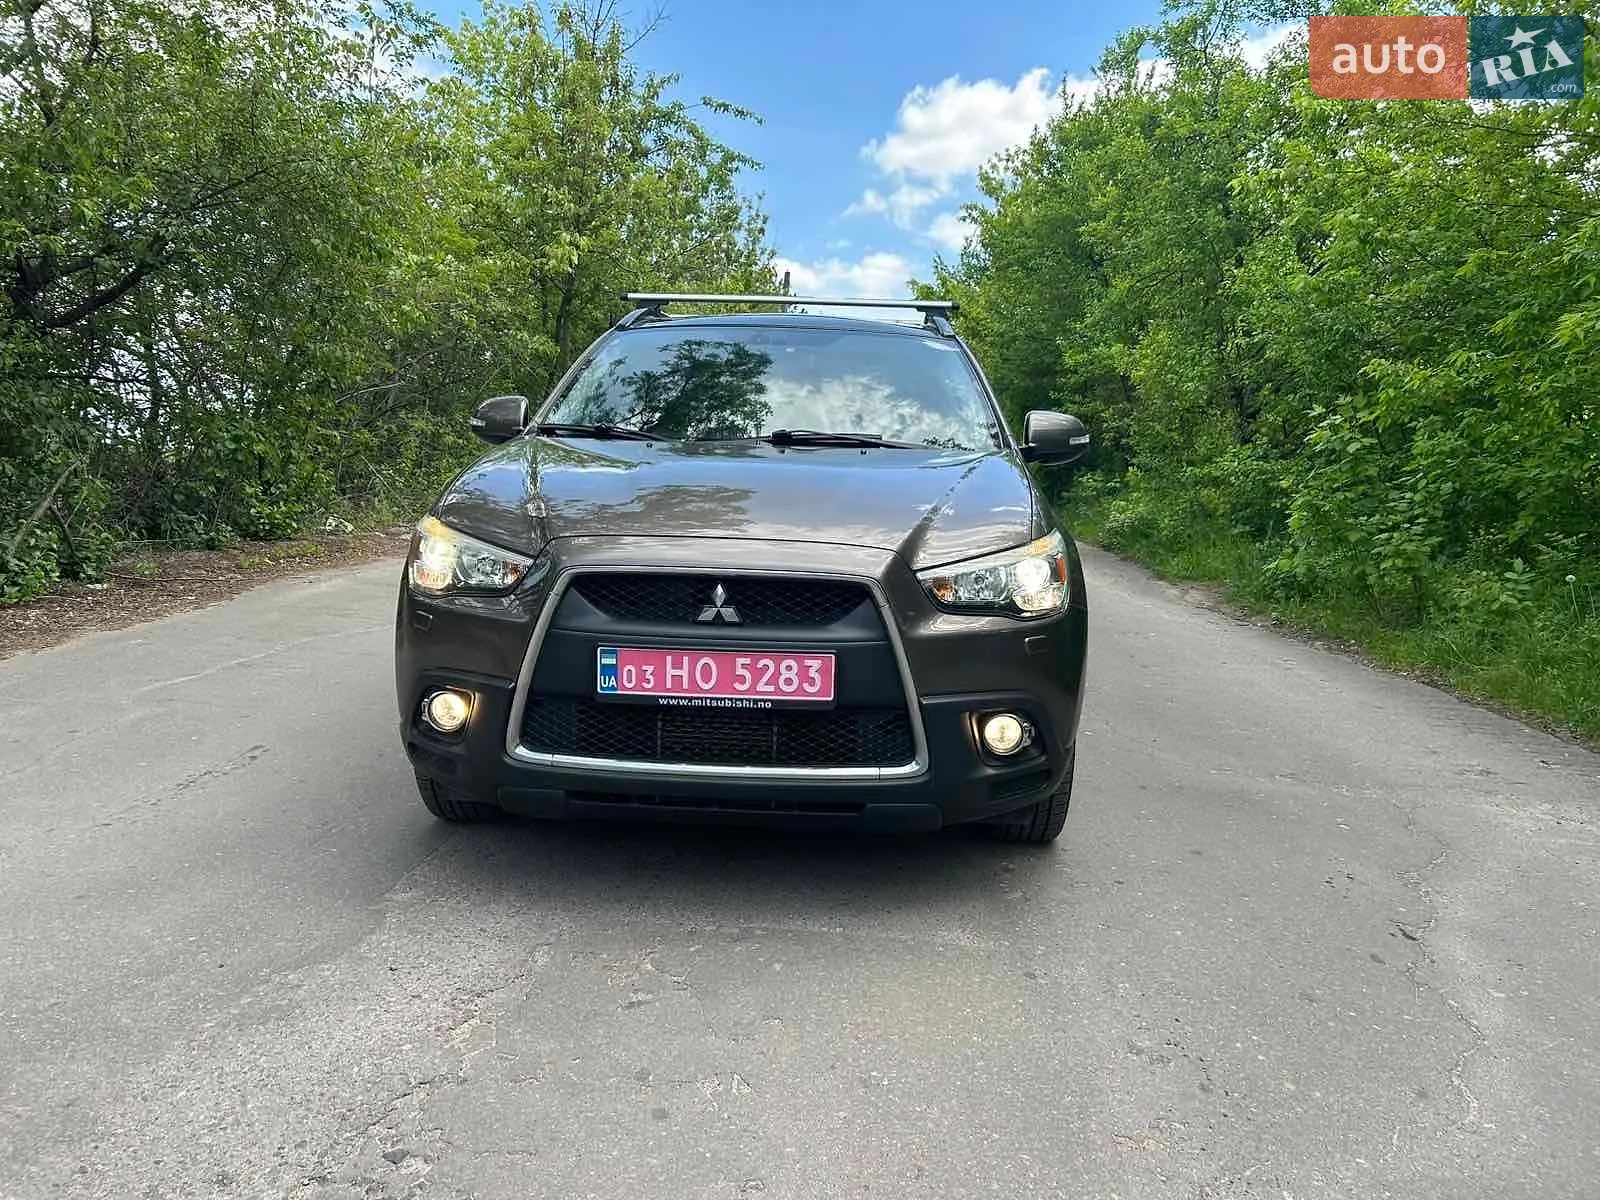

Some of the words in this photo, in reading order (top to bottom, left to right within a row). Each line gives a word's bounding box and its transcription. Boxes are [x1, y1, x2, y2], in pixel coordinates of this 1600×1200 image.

[622, 664, 656, 689] 03
[665, 655, 718, 691] HO
[733, 657, 823, 693] 5283
[600, 675, 617, 688] UA
[658, 696, 772, 709] www.mitsubishi.no
